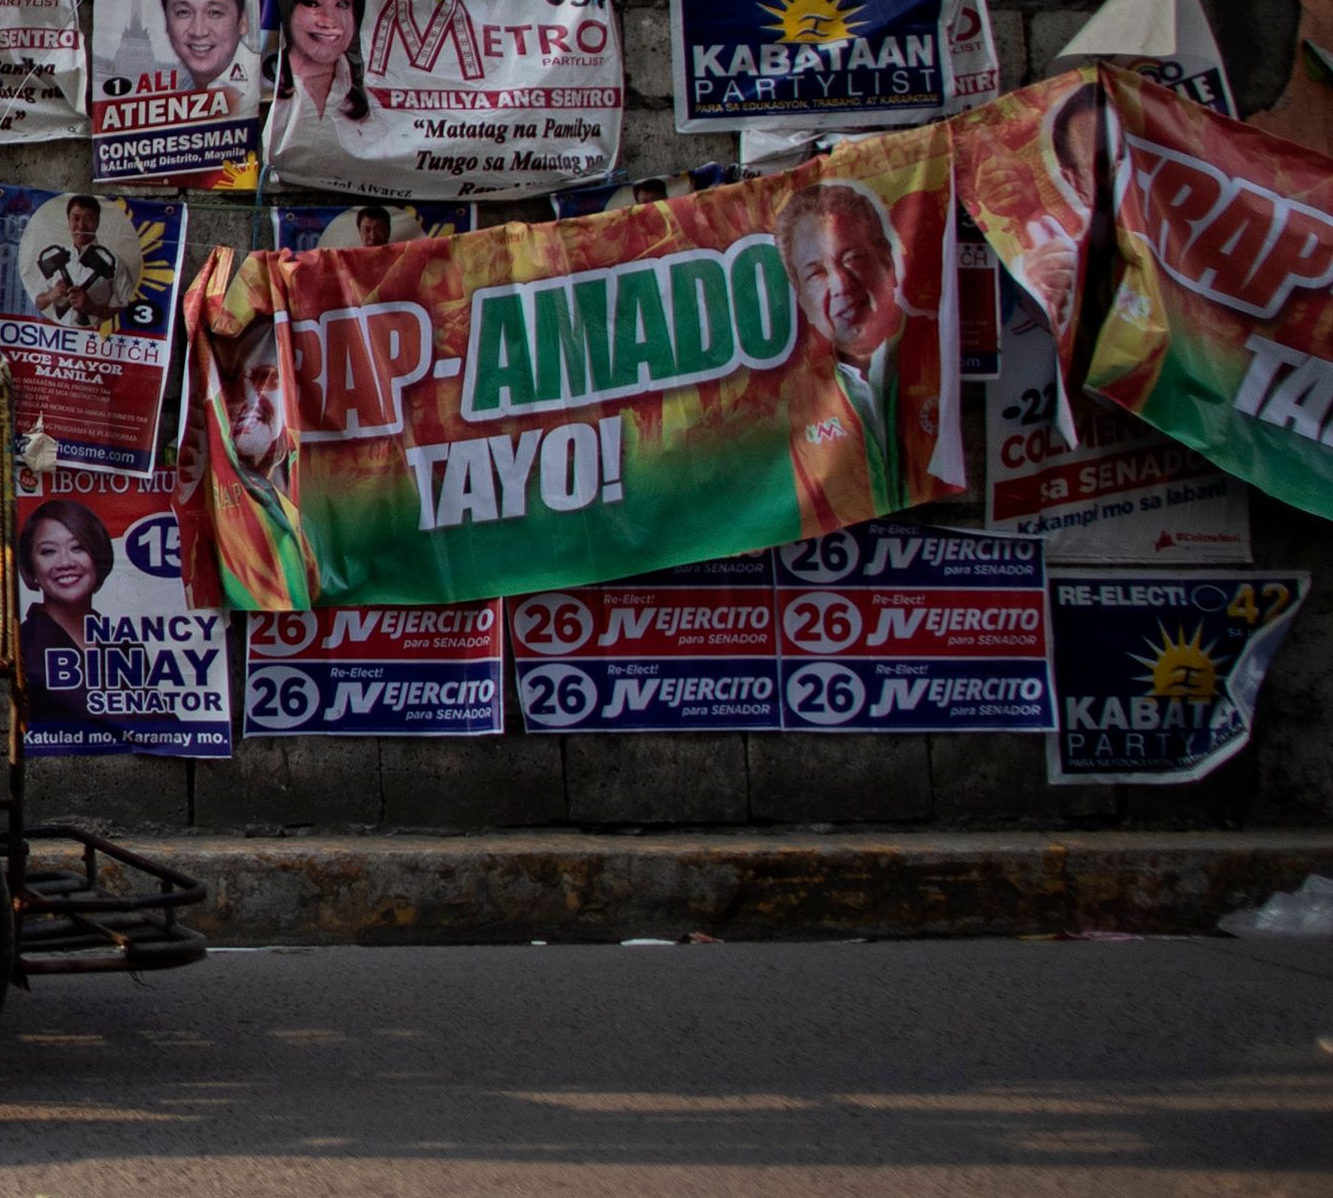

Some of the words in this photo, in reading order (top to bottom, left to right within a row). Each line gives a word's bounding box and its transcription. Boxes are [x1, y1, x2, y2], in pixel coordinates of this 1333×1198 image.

[542, 56, 604, 66] PARTYLIST
[692, 34, 934, 78] KABATAAN
[112, 79, 120, 95] 1
[136, 70, 177, 94] ALI
[695, 69, 937, 103] PARTYLIST
[390, 90, 490, 108] PAMILYA
[497, 90, 546, 107] ANG
[551, 89, 616, 108] SENTRO
[101, 91, 229, 131] ATIENZA
[513, 124, 538, 138] na
[542, 118, 601, 142] Pamilya
[99, 127, 248, 160] CONGRESSMAN
[159, 153, 201, 166] Distrito,
[204, 147, 245, 160] Maynila
[415, 150, 477, 174] Tungo
[484, 157, 504, 171] sa
[509, 150, 582, 174] Matatag
[133, 305, 154, 324] 3
[8, 350, 52, 365] VICE
[58, 357, 123, 376] MAYOR
[85, 341, 159, 363] BUTCH
[35, 365, 104, 385] MANILA
[51, 470, 130, 494] IBOTO
[407, 416, 626, 532] TAYO!
[1040, 478, 1069, 502] sa
[1103, 501, 1133, 518] mo
[1140, 494, 1161, 510] sa
[1166, 478, 1227, 506] laban!
[1058, 585, 1189, 606] RE-ELECT!
[83, 614, 218, 645] NANCY
[45, 648, 220, 690] BINAY
[87, 690, 223, 714] SENATOR
[22, 730, 83, 745] Katulad
[88, 732, 117, 746] mo,
[122, 730, 192, 747] Karamay
[197, 732, 229, 744] mo.
